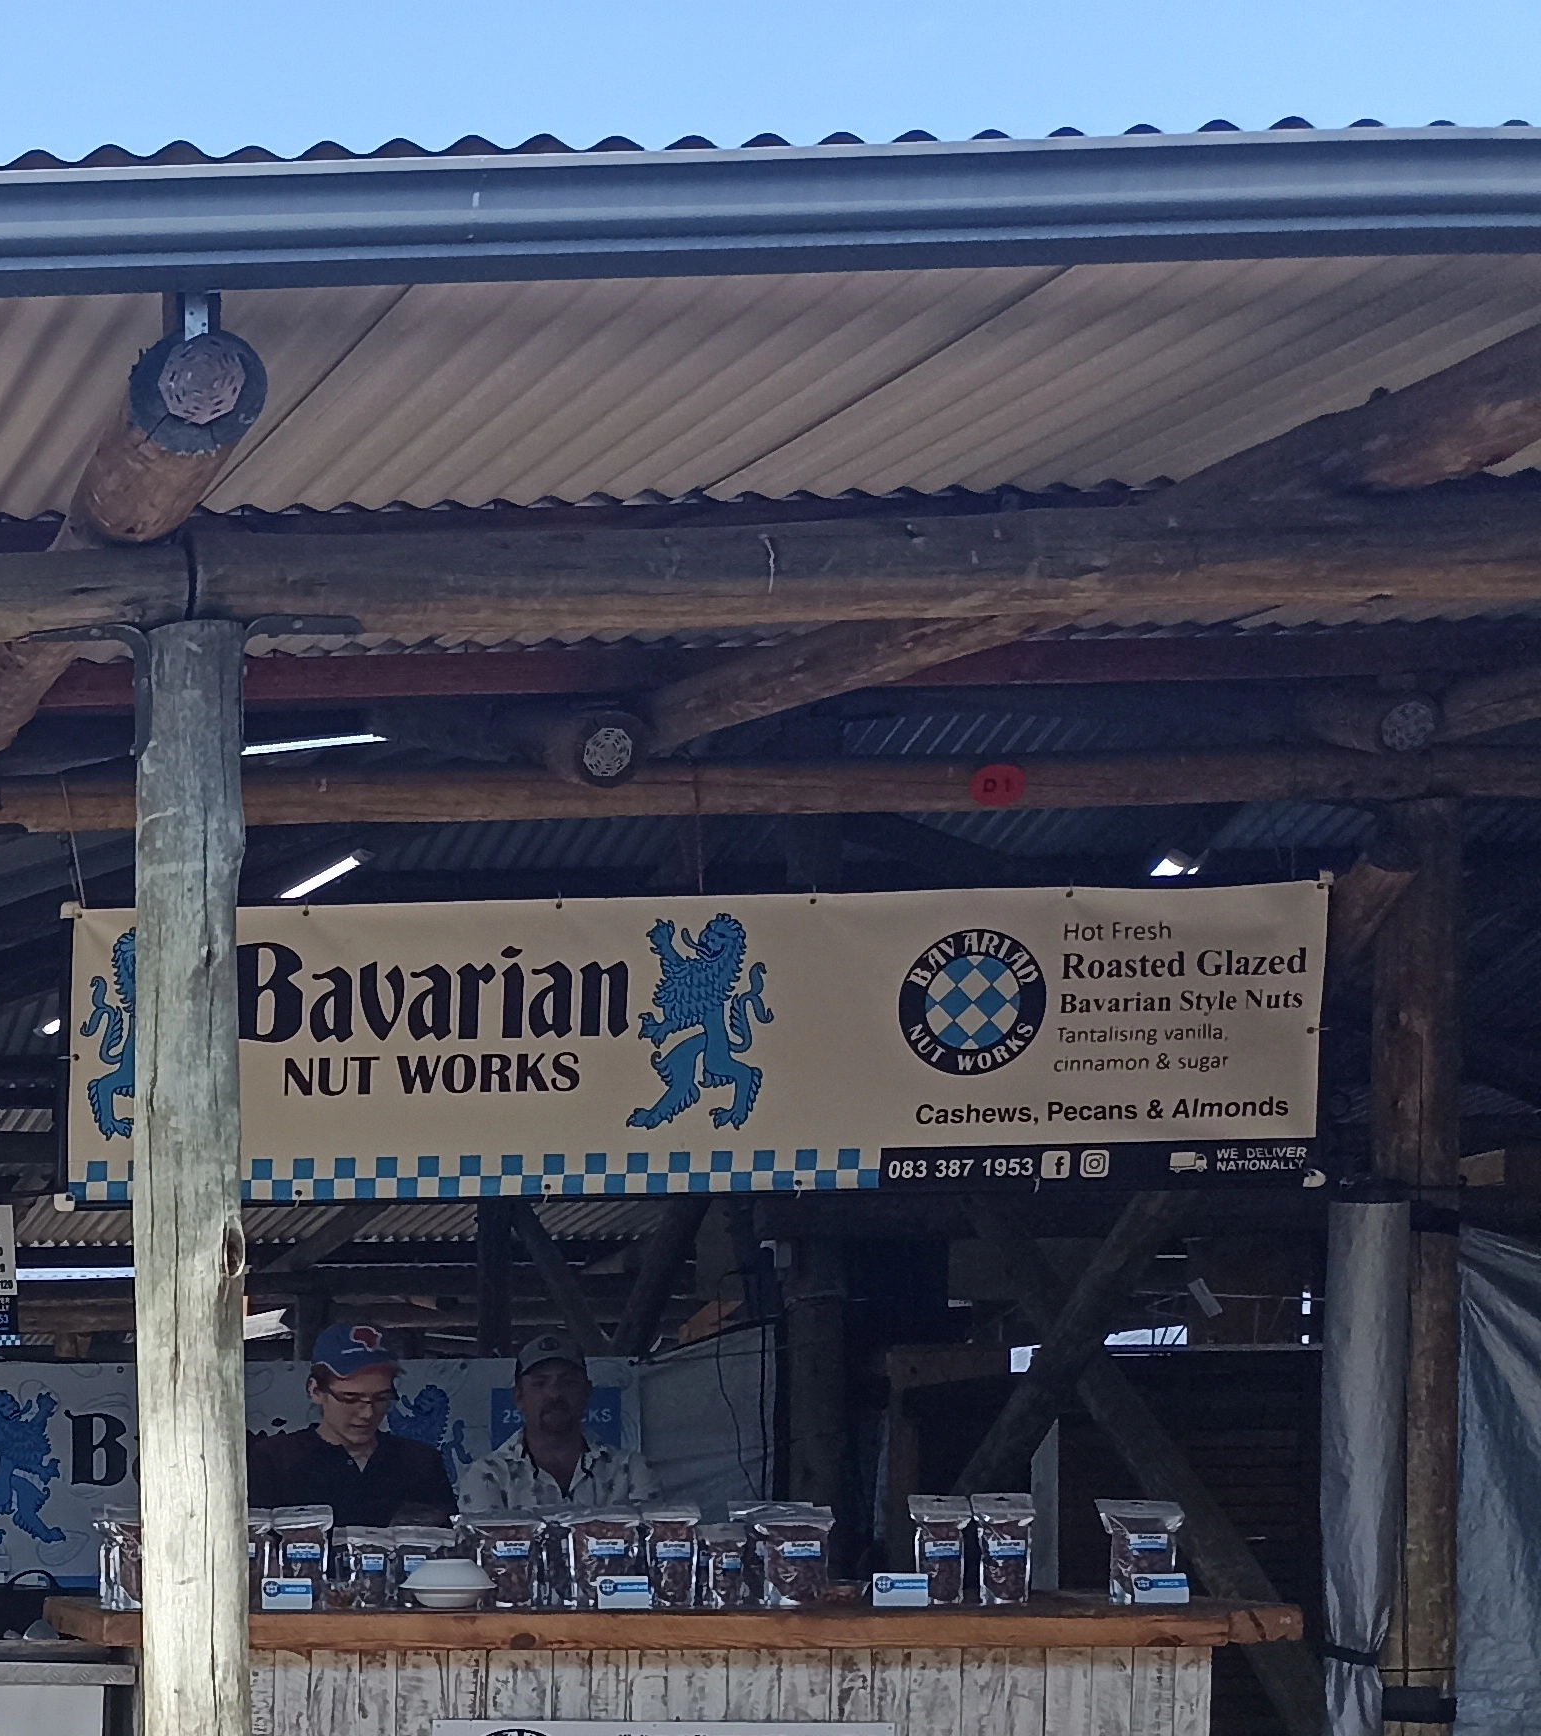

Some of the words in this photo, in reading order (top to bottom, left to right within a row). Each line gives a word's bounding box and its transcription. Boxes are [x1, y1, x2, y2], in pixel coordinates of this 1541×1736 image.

[1063, 922, 1104, 941] Hot
[1112, 920, 1172, 940] Fresh
[907, 932, 1038, 987] BAVARIAN
[1062, 951, 1185, 979] Roasted
[1197, 947, 1307, 976] Glazed
[236, 942, 629, 1043] Bavarian
[1060, 992, 1171, 1013] Bavarian
[1179, 990, 1237, 1016] Style
[1246, 989, 1303, 1009] Nuts
[908, 1023, 945, 1062] NUT
[957, 1023, 1033, 1070] WORKS
[1057, 1026, 1157, 1045] Tantalising
[284, 1056, 380, 1097] NUT
[395, 1052, 580, 1094] WORKS
[1053, 1056, 1149, 1072] cinnamon
[1156, 1053, 1170, 1070] &
[1178, 1055, 1229, 1072] sugar
[915, 1103, 1038, 1125] Cashews,
[1047, 1101, 1138, 1122] Pecans
[1146, 1099, 1164, 1119] &
[1171, 1096, 1289, 1119] Almonds
[1216, 1148, 1239, 1159] WE
[1246, 1147, 1307, 1159] DELIVER
[1216, 1159, 1305, 1171] NATIONALLY
[888, 1161, 927, 1178] 083
[935, 1159, 974, 1177] 387
[982, 1158, 1034, 1177] 1953
